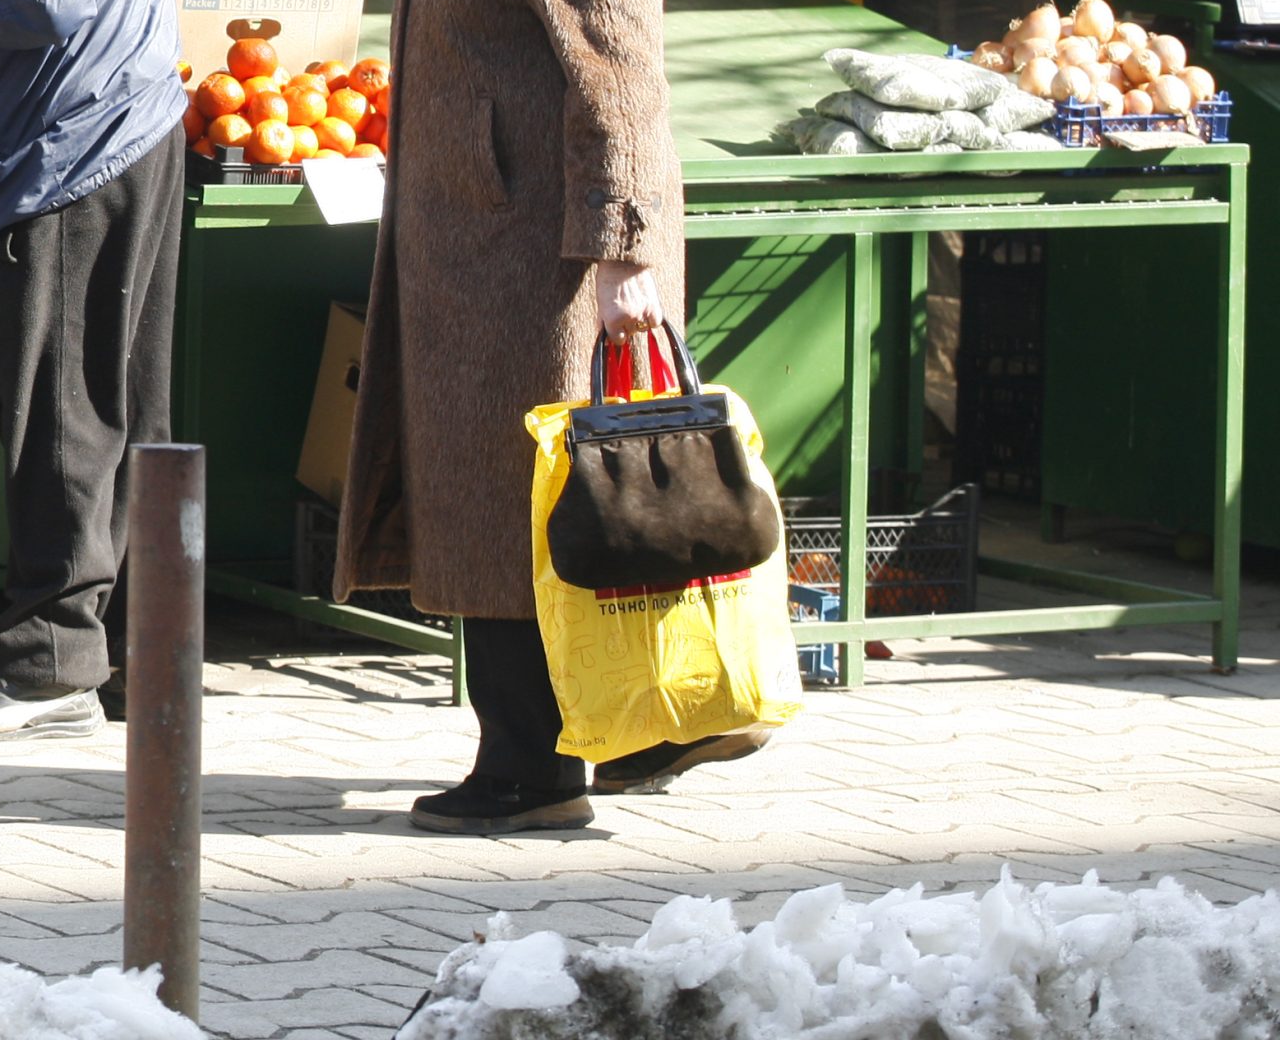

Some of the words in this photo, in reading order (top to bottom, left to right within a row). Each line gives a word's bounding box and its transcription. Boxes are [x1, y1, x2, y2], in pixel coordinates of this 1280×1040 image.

[286, 0, 293, 8] 6
[298, 0, 306, 8] 7
[311, 0, 318, 8] 8
[322, 0, 330, 8] 9
[599, 599, 646, 615] ТОЧНО
[652, 597, 669, 611] ПО
[675, 590, 707, 607] МОЯ
